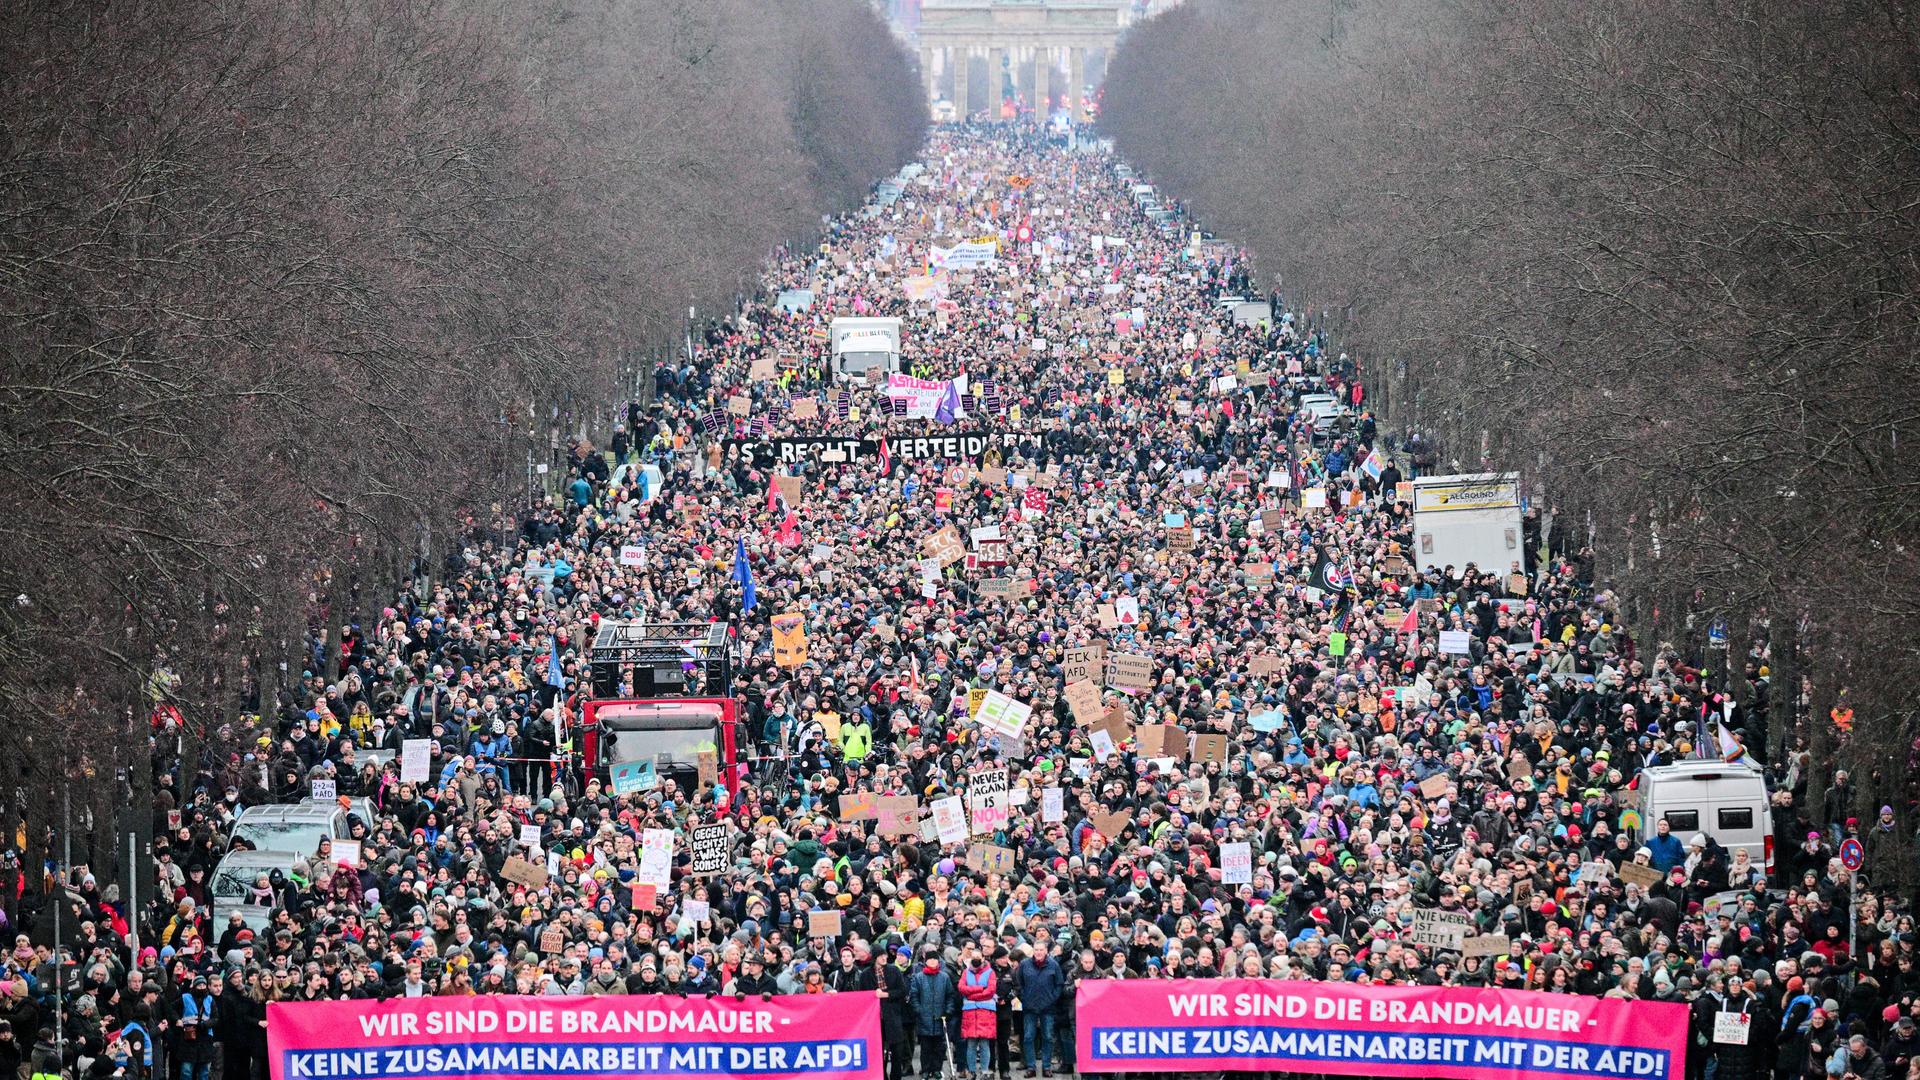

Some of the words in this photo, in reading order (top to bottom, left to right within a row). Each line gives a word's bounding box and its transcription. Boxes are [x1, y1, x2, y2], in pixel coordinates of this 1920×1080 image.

[1450, 491, 1495, 500] ALLROUND
[980, 543, 1005, 553] FCK
[1067, 652, 1091, 664] FCK
[1067, 666, 1086, 678] AFD
[972, 771, 1004, 785] NEVER
[313, 781, 335, 790] 2+2=4
[973, 783, 1006, 797] AGAIN
[984, 796, 995, 808] IS
[972, 806, 1007, 824] NOW
[694, 826, 725, 840] GEGEN
[692, 837, 728, 852] RECHTS!
[1223, 856, 1250, 867] IDEEN
[1416, 910, 1437, 922] NIE
[1438, 913, 1467, 925] WIEDER
[1414, 923, 1433, 931] IST
[542, 932, 563, 941] GEGEN
[542, 941, 563, 952] RECHTS
[1168, 994, 1228, 1016] WIR
[1234, 994, 1307, 1018] SIND
[1314, 995, 1363, 1018] DIE
[1372, 997, 1580, 1032] BRANDMAUER
[359, 1013, 419, 1036] WIR
[426, 1011, 498, 1034] SIND
[506, 1010, 554, 1033] DIE
[564, 1010, 773, 1032] BRANDMAUER
[292, 1052, 378, 1076] KEINE
[385, 1047, 663, 1073] ZUSAMMENARBEIT
[669, 1047, 723, 1070] MIT
[731, 1047, 788, 1069] DER
[794, 1043, 861, 1068] AFD!
[1100, 1032, 1186, 1054] KEINE
[1193, 1030, 1470, 1062] ZUSAMMENARBEIT
[1477, 1039, 1527, 1065] MIT
[1537, 1043, 1590, 1069] DER
[1595, 1050, 1664, 1076] AFD!
